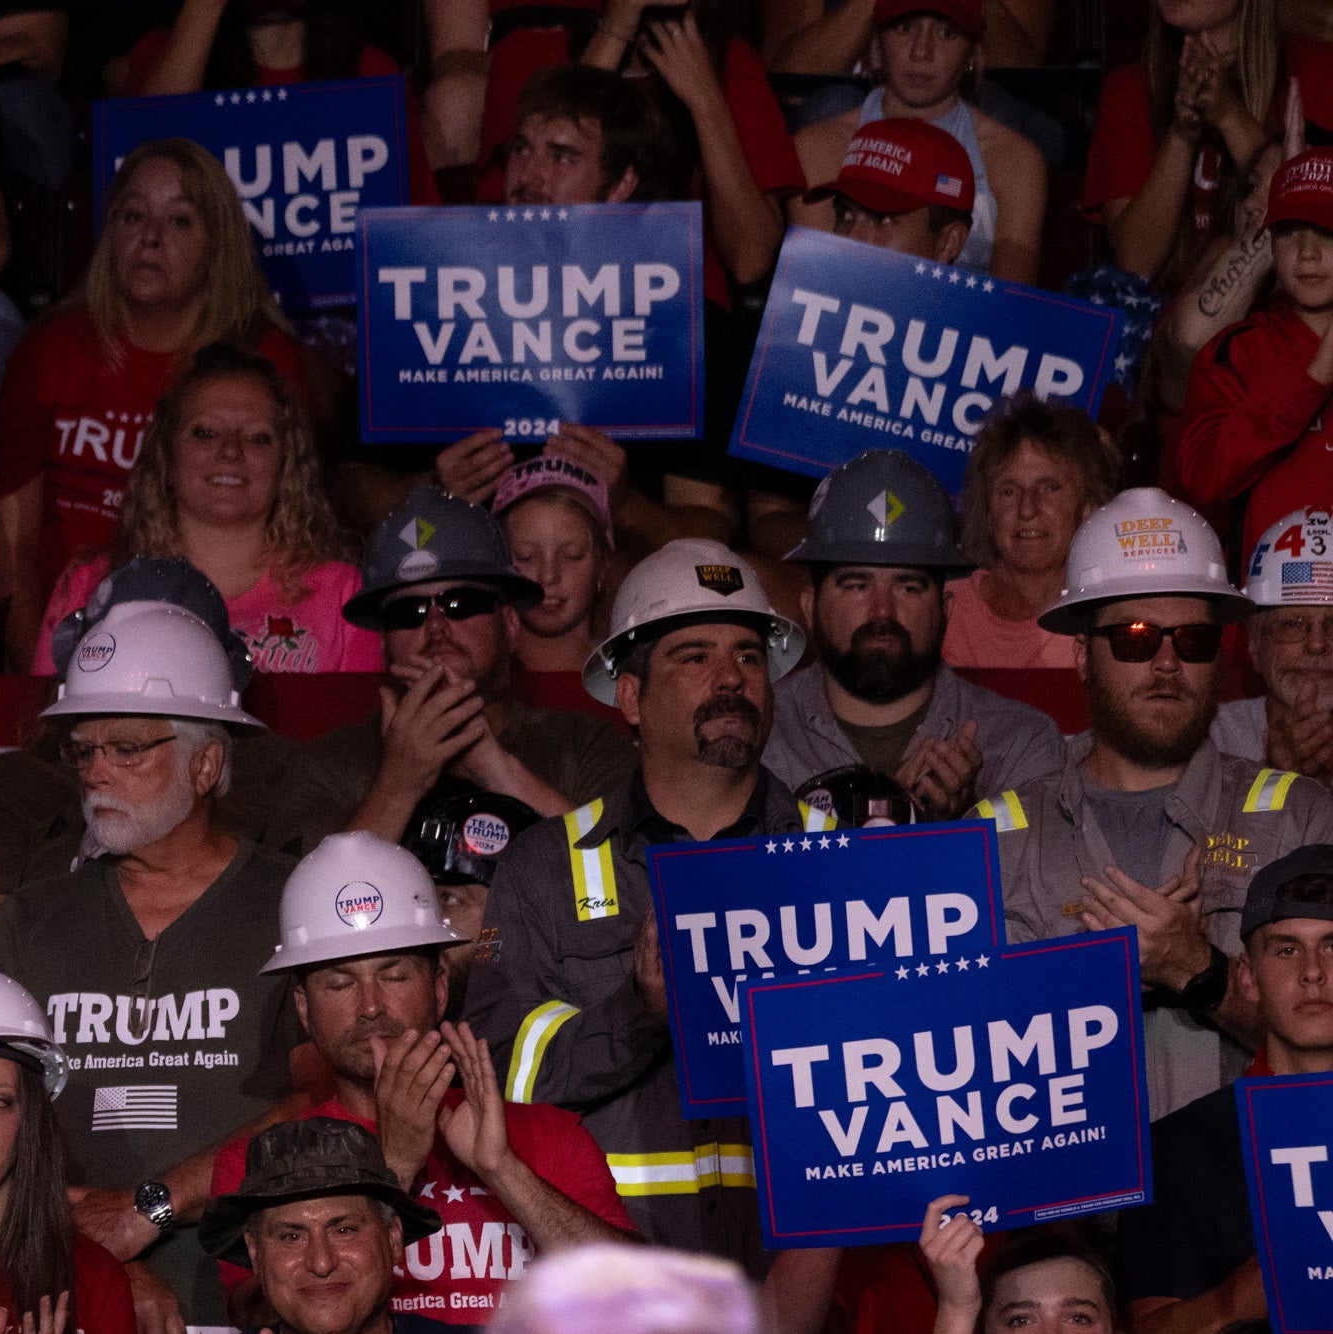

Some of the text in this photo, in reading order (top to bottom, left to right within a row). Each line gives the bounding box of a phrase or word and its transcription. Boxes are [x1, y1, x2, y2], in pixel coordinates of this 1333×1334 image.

[379, 264, 680, 320] TRUMP
[414, 319, 647, 364] VANCE
[791, 289, 1083, 403] TRUMP
[399, 366, 663, 382] MAKE AMERICA GREAT AGAIN!
[812, 351, 992, 436] VANC
[505, 418, 559, 436] 2024
[514, 459, 599, 491] TRUMP
[1121, 517, 1175, 534] DEEP
[1118, 534, 1177, 550] WELL
[1311, 540, 1328, 558] 3
[1123, 549, 1177, 558] SERVICES
[80, 646, 113, 658] TRUMP
[466, 825, 508, 842] TRUMP
[472, 818, 505, 832] TEAM
[474, 840, 496, 850] 2024
[337, 896, 380, 911] TRUMP
[343, 903, 378, 913] VANCE
[577, 895, 617, 912] Kris
[676, 893, 978, 972] TRUMP
[47, 988, 240, 1046] TRUMP
[85, 1049, 239, 1069] America Great Again
[772, 1005, 1119, 1108] TRUMP
[819, 1074, 1088, 1158] VANCE
[806, 1126, 1105, 1180] MAKE AMERICA GREAT AGAIN!
